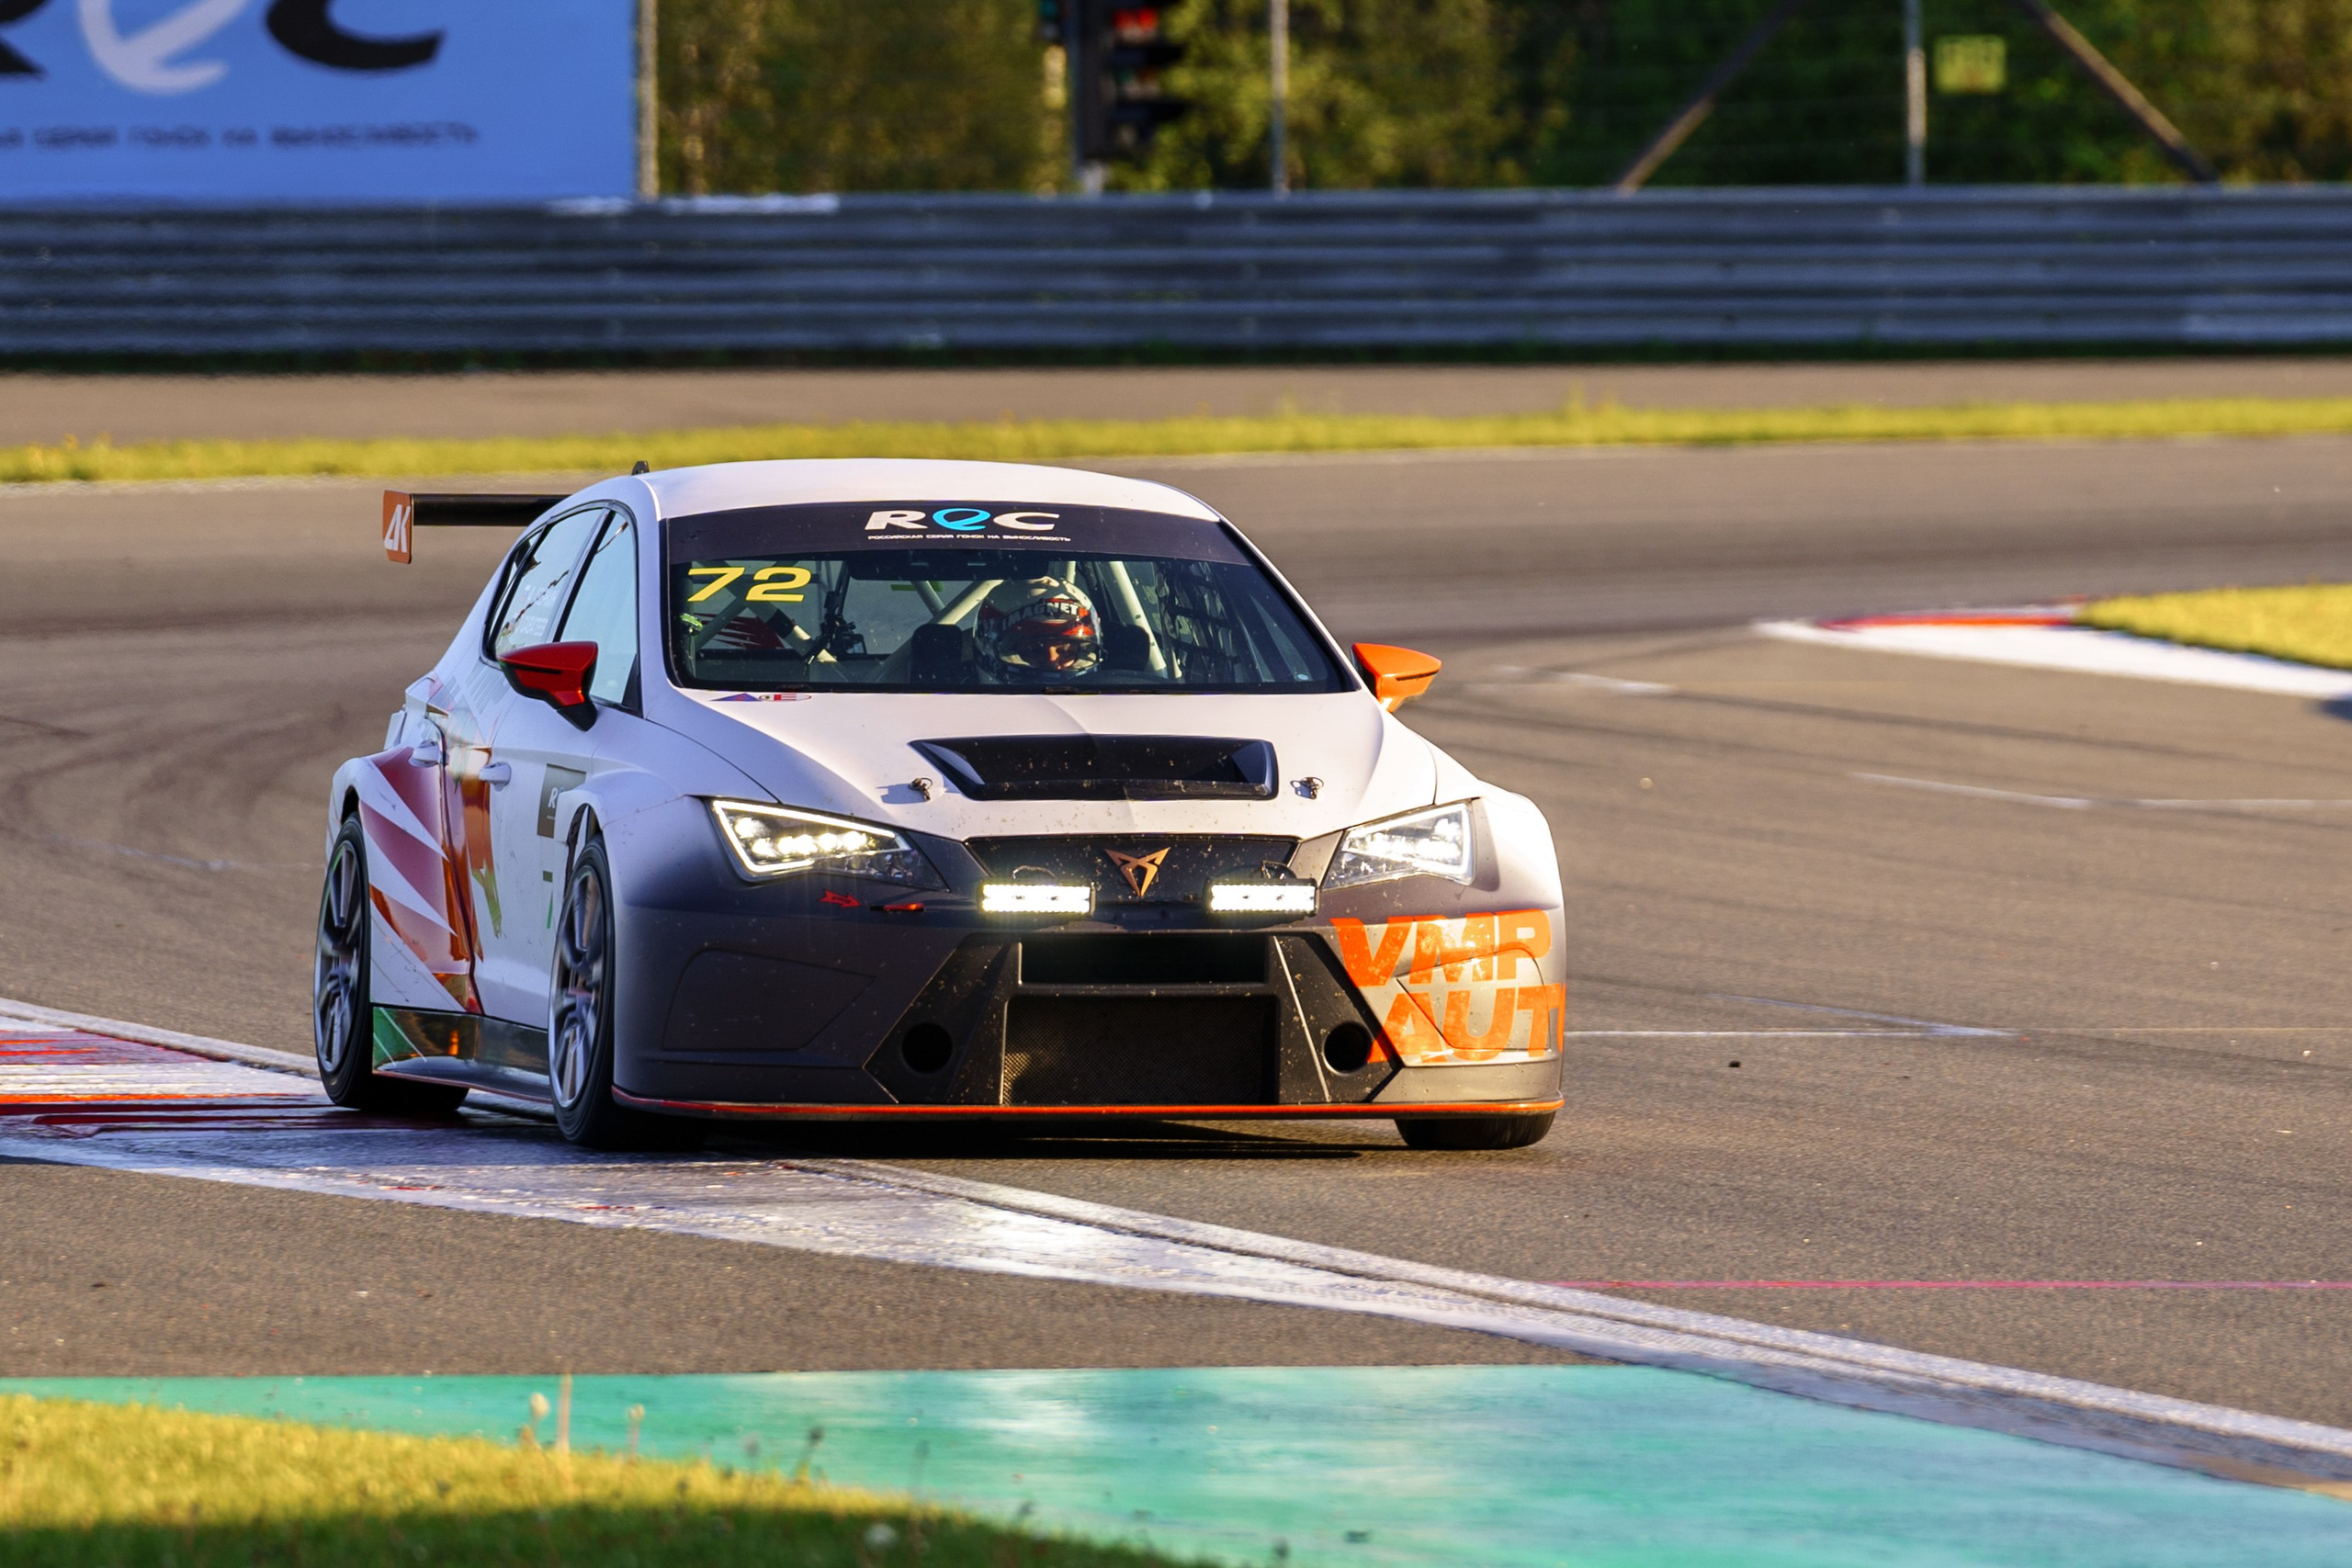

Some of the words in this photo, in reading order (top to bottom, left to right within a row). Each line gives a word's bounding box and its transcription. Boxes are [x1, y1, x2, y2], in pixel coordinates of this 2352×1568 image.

[687, 567, 812, 602] 72
[1329, 908, 1553, 987] VMP
[1367, 982, 1566, 1064] AUT
